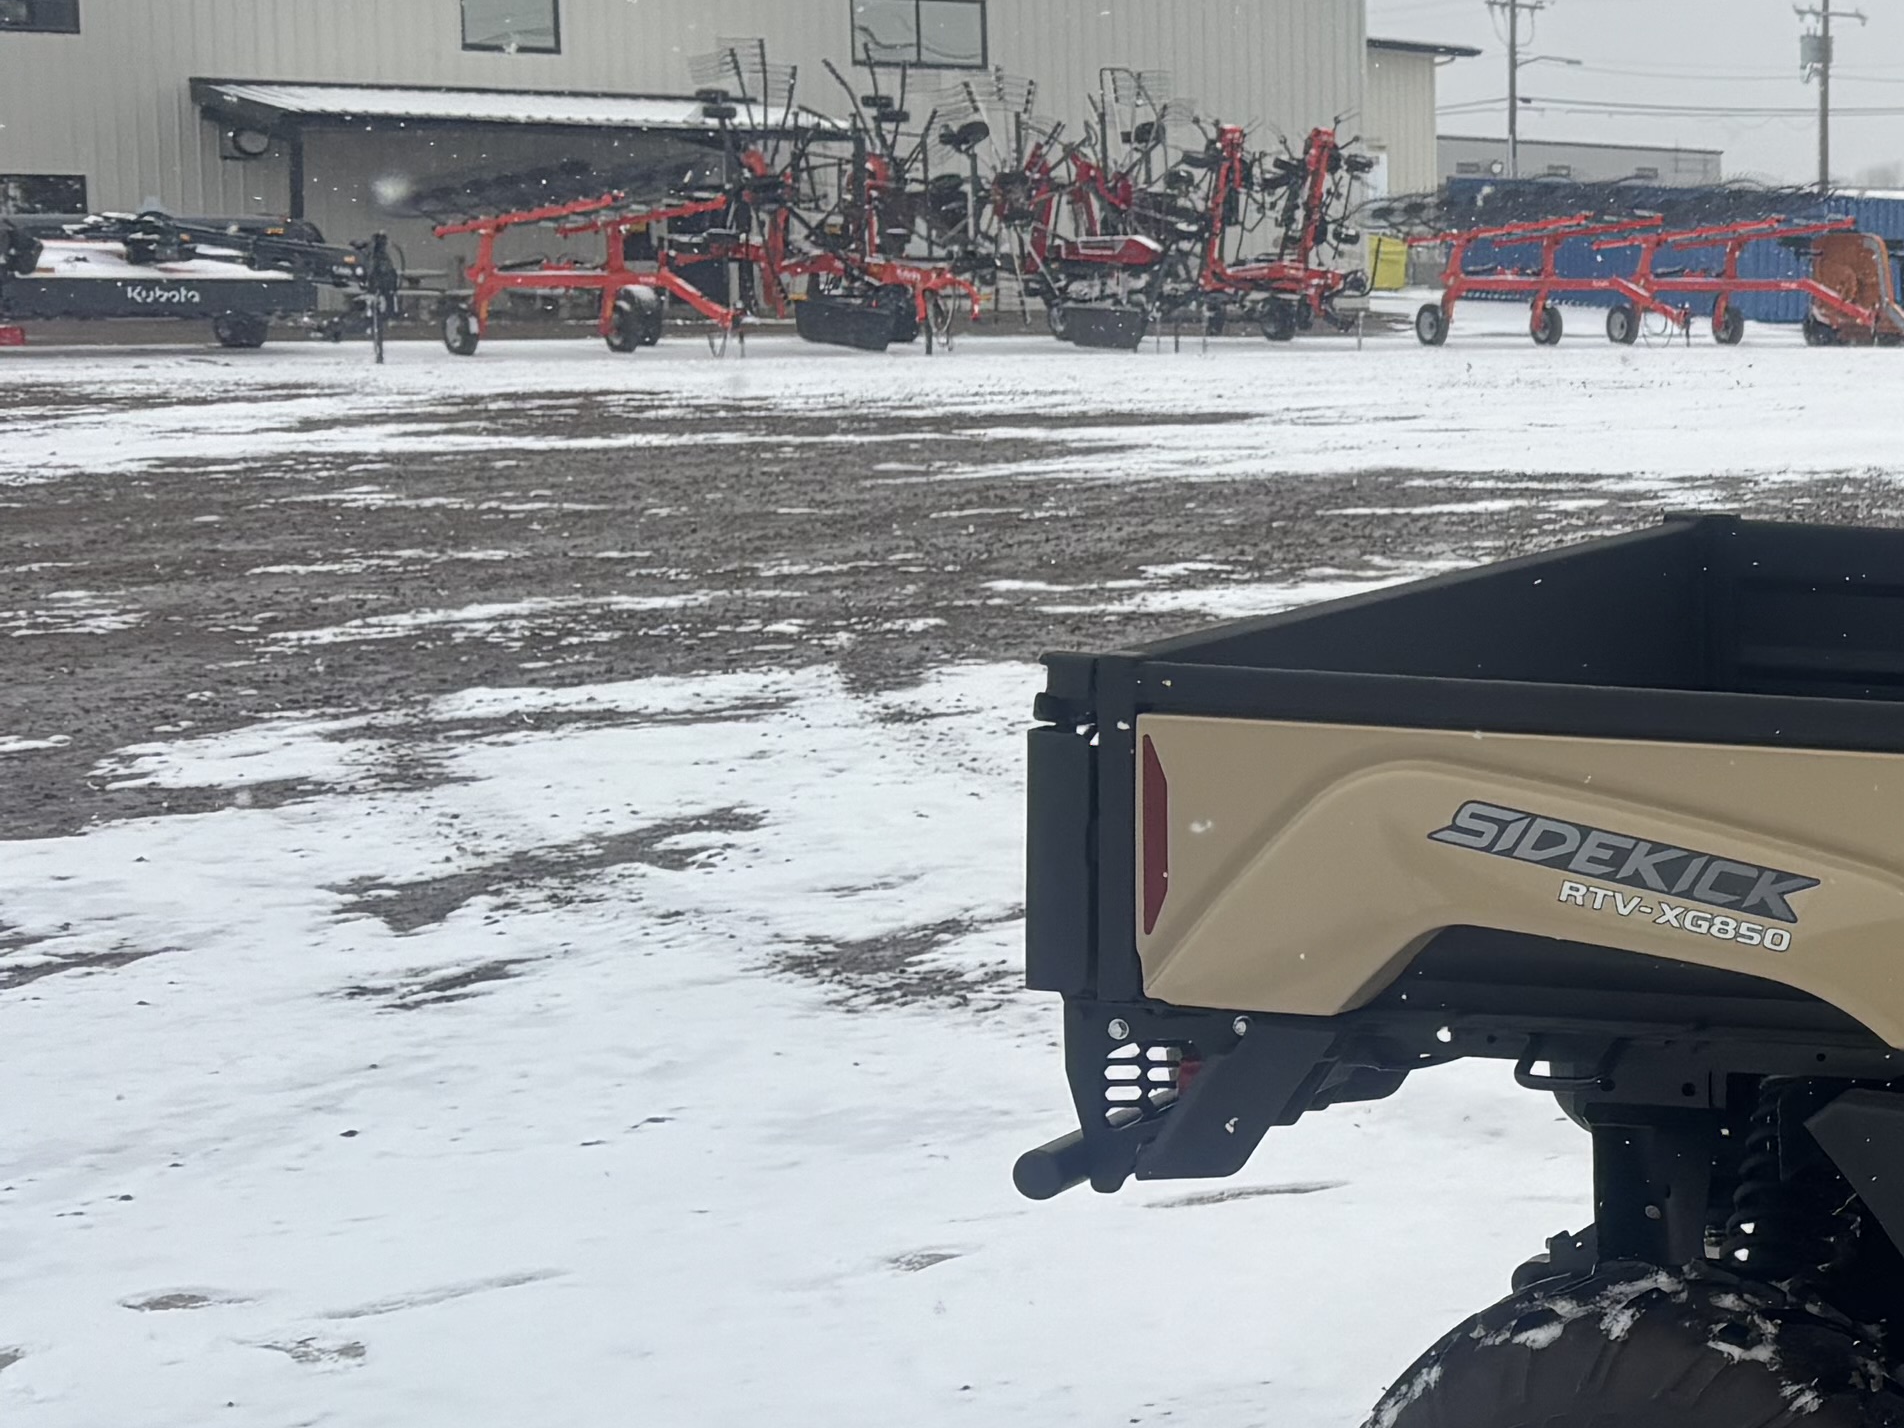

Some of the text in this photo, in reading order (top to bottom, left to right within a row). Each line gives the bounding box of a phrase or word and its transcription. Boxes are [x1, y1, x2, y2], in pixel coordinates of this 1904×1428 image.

[127, 286, 200, 303] Kubota
[1429, 801, 1816, 922] SIDEKICK
[1558, 880, 1792, 953] RTV-XG850
